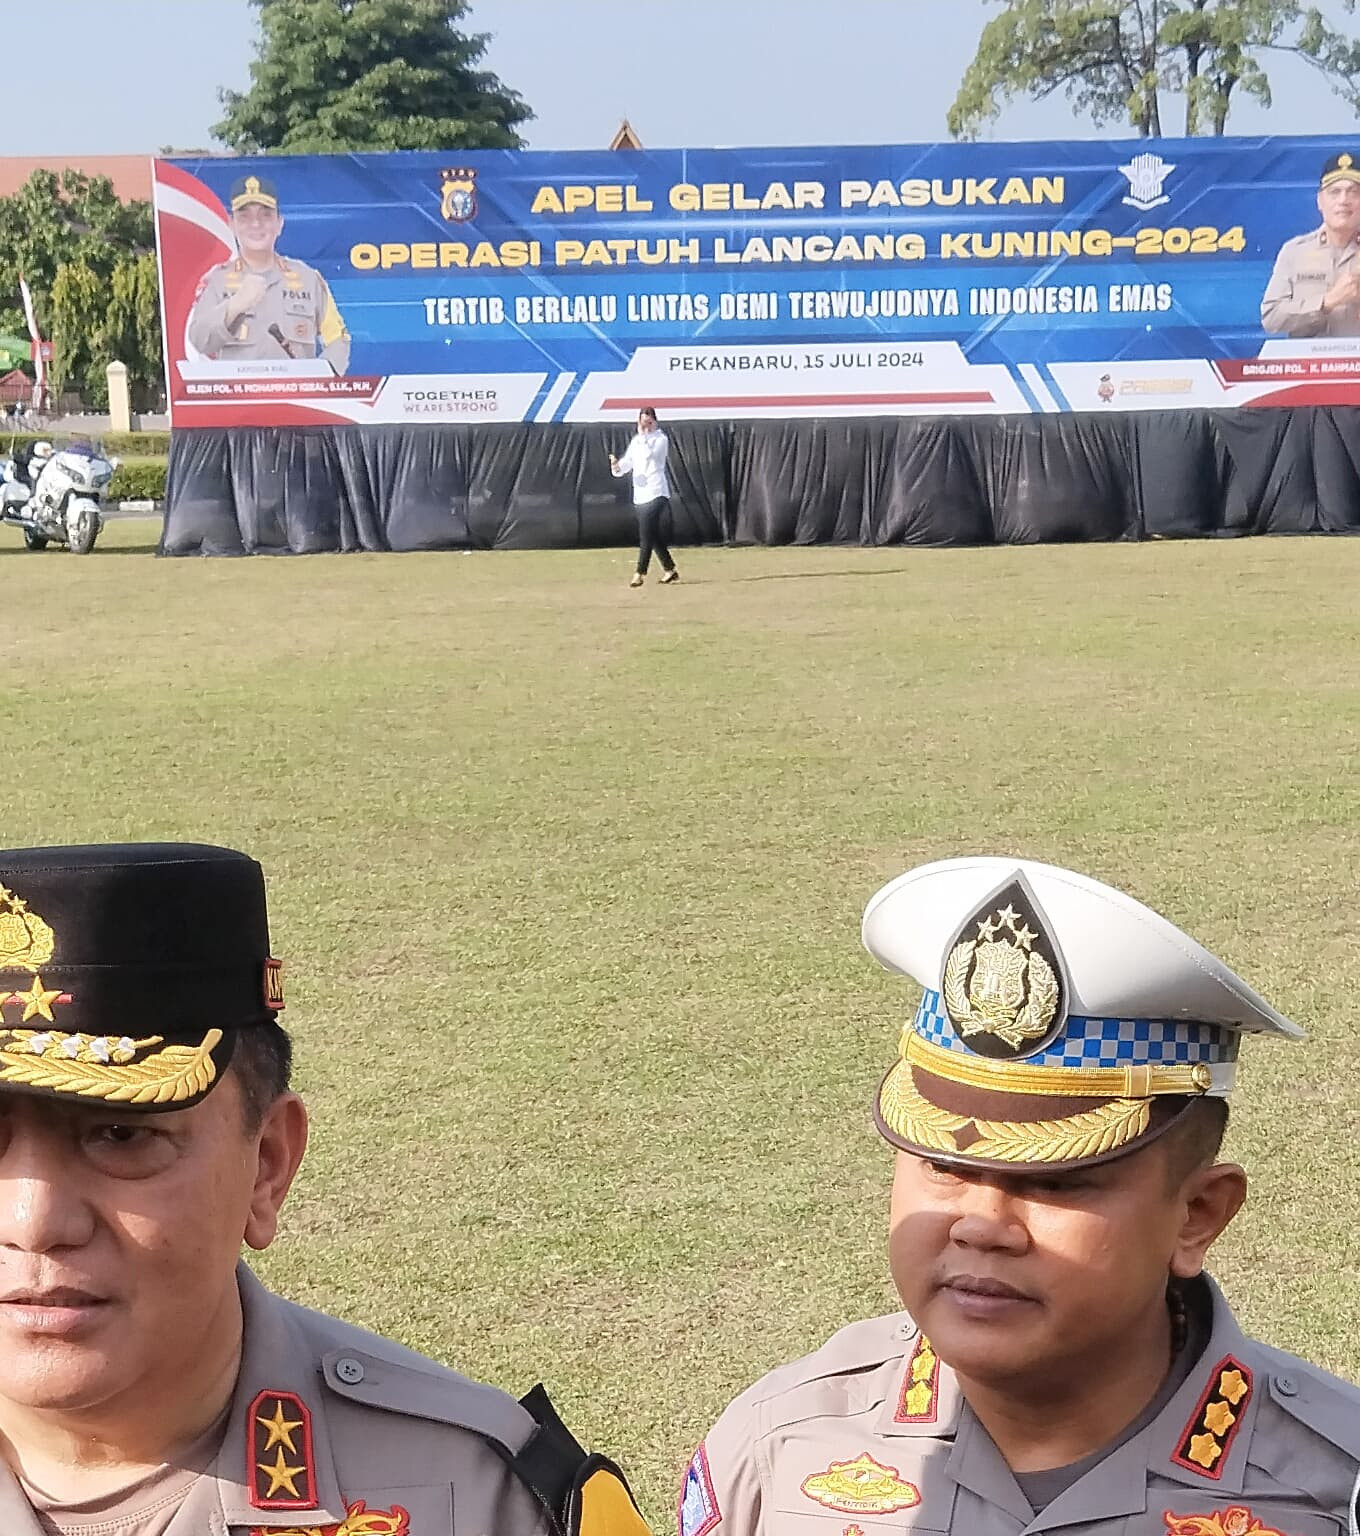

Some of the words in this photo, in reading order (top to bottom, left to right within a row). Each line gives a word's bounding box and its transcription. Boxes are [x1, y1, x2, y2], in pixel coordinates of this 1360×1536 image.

[531, 185, 654, 214] APEL
[669, 181, 826, 212] GELAR
[840, 176, 1065, 208] PASUKAN
[349, 240, 541, 270] OPERASI
[554, 238, 700, 267] PATUH
[714, 232, 927, 264] LANCANG
[941, 226, 1246, 260] KUNING-2024
[424, 297, 505, 326] TERTIB
[515, 295, 617, 324] BERLALU
[627, 293, 710, 323] LINTAS
[720, 291, 779, 321] DEMI
[787, 288, 960, 320] TERWUJUDNYA
[970, 285, 1099, 316] INDONESIA
[1108, 282, 1173, 313] EMAS
[669, 355, 798, 371] PEKANBARU,
[803, 354, 824, 369] 15
[829, 353, 872, 369] JULI
[877, 352, 924, 368] 2024
[402, 390, 497, 401] TOGETHER
